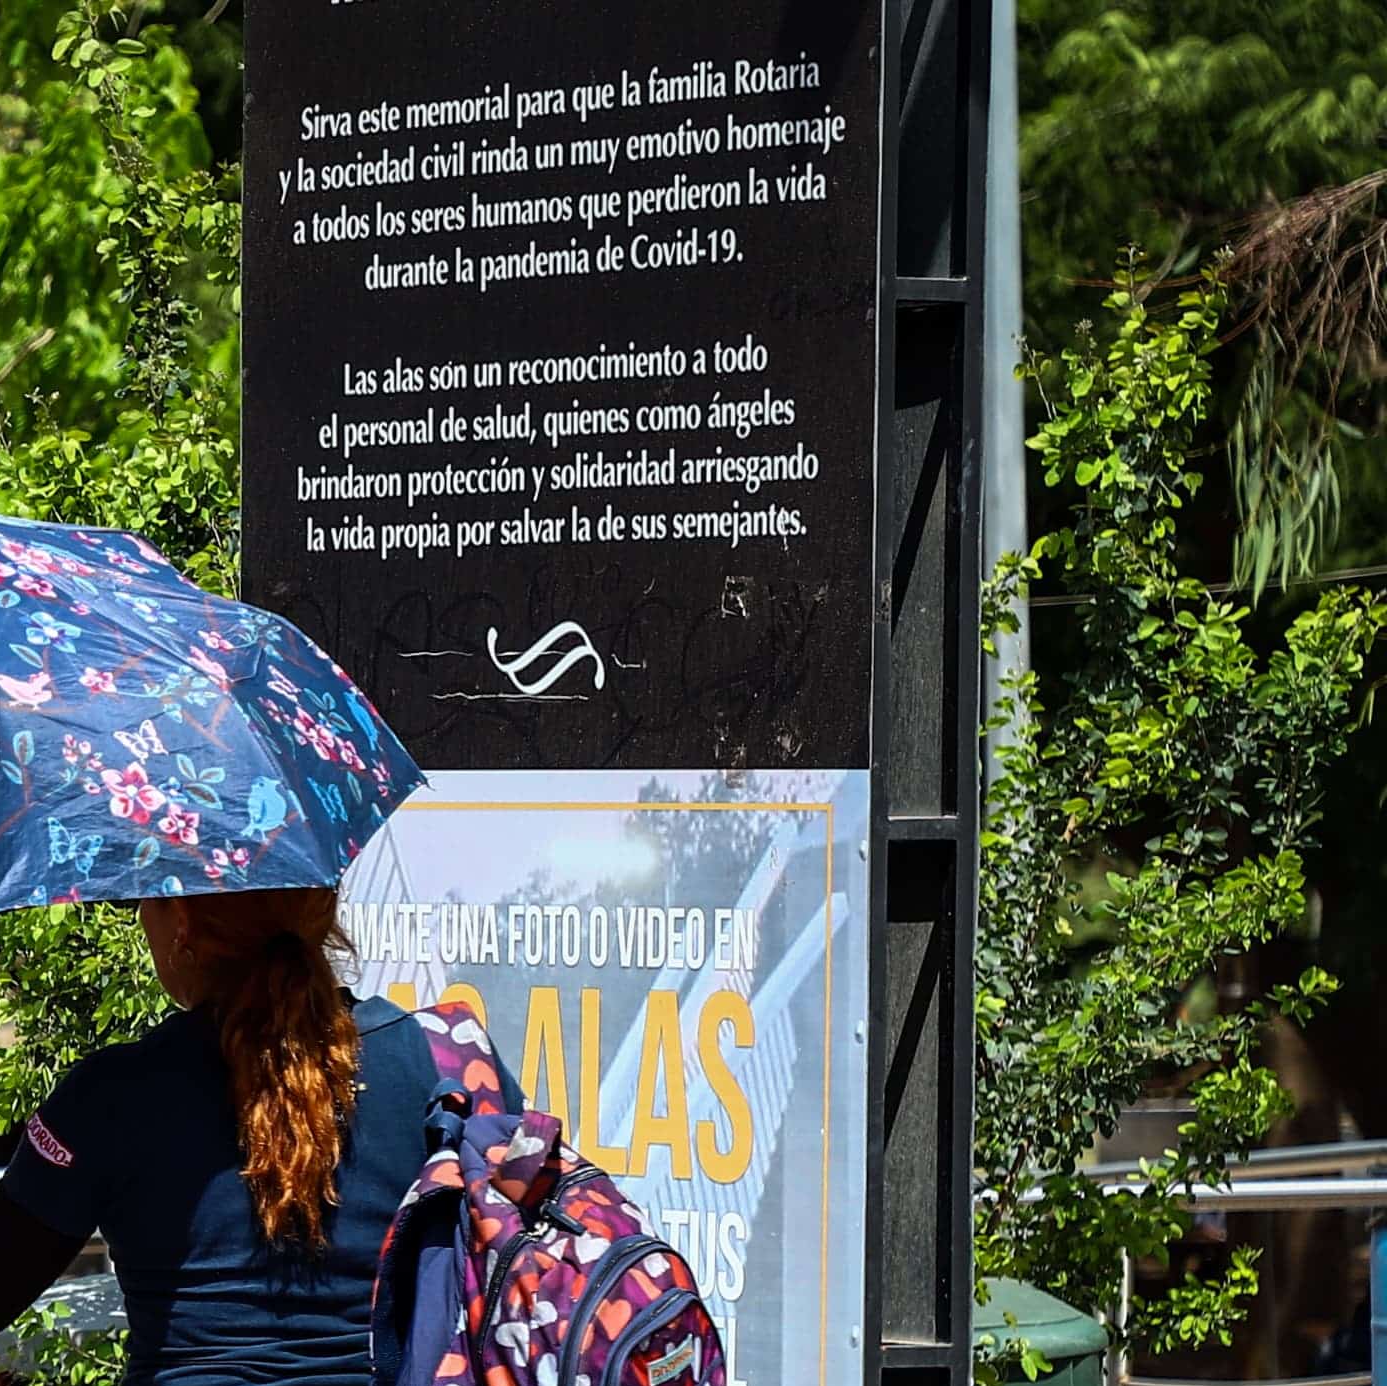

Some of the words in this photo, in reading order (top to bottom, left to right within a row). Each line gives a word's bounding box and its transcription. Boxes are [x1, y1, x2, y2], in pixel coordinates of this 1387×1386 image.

[301, 103, 353, 141] Sirva
[358, 101, 401, 134] este
[406, 82, 510, 129] memorial
[516, 89, 566, 129] para
[572, 83, 615, 123] que
[621, 69, 642, 107] la
[648, 61, 727, 104] familia
[735, 51, 820, 95] Rotaria
[279, 170, 292, 205] y
[297, 157, 316, 192] la
[321, 145, 415, 190] sociedad
[420, 140, 465, 180] civil
[471, 135, 529, 175] rinda
[535, 142, 564, 170] un
[570, 137, 620, 174] muy
[626, 118, 720, 161] emotivo
[727, 105, 846, 155] homenaje
[293, 220, 306, 245] a
[312, 204, 370, 243] todos
[376, 201, 406, 237] los
[411, 205, 466, 235] seres
[471, 192, 573, 228] humanos
[578, 191, 621, 230] que
[627, 173, 742, 227] perdieron
[748, 167, 769, 205] la
[776, 162, 826, 202] vida
[365, 253, 449, 291] durante
[455, 246, 474, 283] la
[480, 237, 590, 293] pandemia
[596, 234, 624, 272] de
[630, 227, 743, 269] Covid-19.
[344, 363, 378, 395] Las
[382, 356, 424, 394] alas
[429, 360, 467, 391] son
[473, 362, 502, 388] un
[508, 341, 687, 386] reconocimiento
[692, 348, 707, 375] a
[713, 333, 768, 374] todo
[319, 412, 338, 449] el
[344, 407, 434, 459] personal
[439, 406, 468, 443] de
[472, 401, 537, 445] salud,
[543, 399, 630, 448] quienes
[636, 404, 702, 432] como
[707, 388, 795, 439] ángeles
[297, 463, 402, 501] brindaron
[408, 456, 525, 508] protección
[531, 466, 545, 502] y
[550, 447, 675, 490] solidaridad
[681, 442, 819, 494] arriesgando
[306, 516, 326, 552] la
[330, 514, 376, 550] vida
[381, 511, 451, 560] propia
[457, 520, 496, 558] por
[500, 507, 566, 545] salvar
[571, 505, 591, 542] la
[597, 504, 626, 541] de
[631, 514, 667, 540] sus
[672, 500, 807, 551] semejantes.
[440, 903, 500, 965] UNA
[507, 905, 580, 968] FOTO
[588, 907, 609, 967] O
[616, 907, 706, 970] VIDEO
[713, 909, 756, 971] EN
[521, 986, 755, 1184] ALAS
